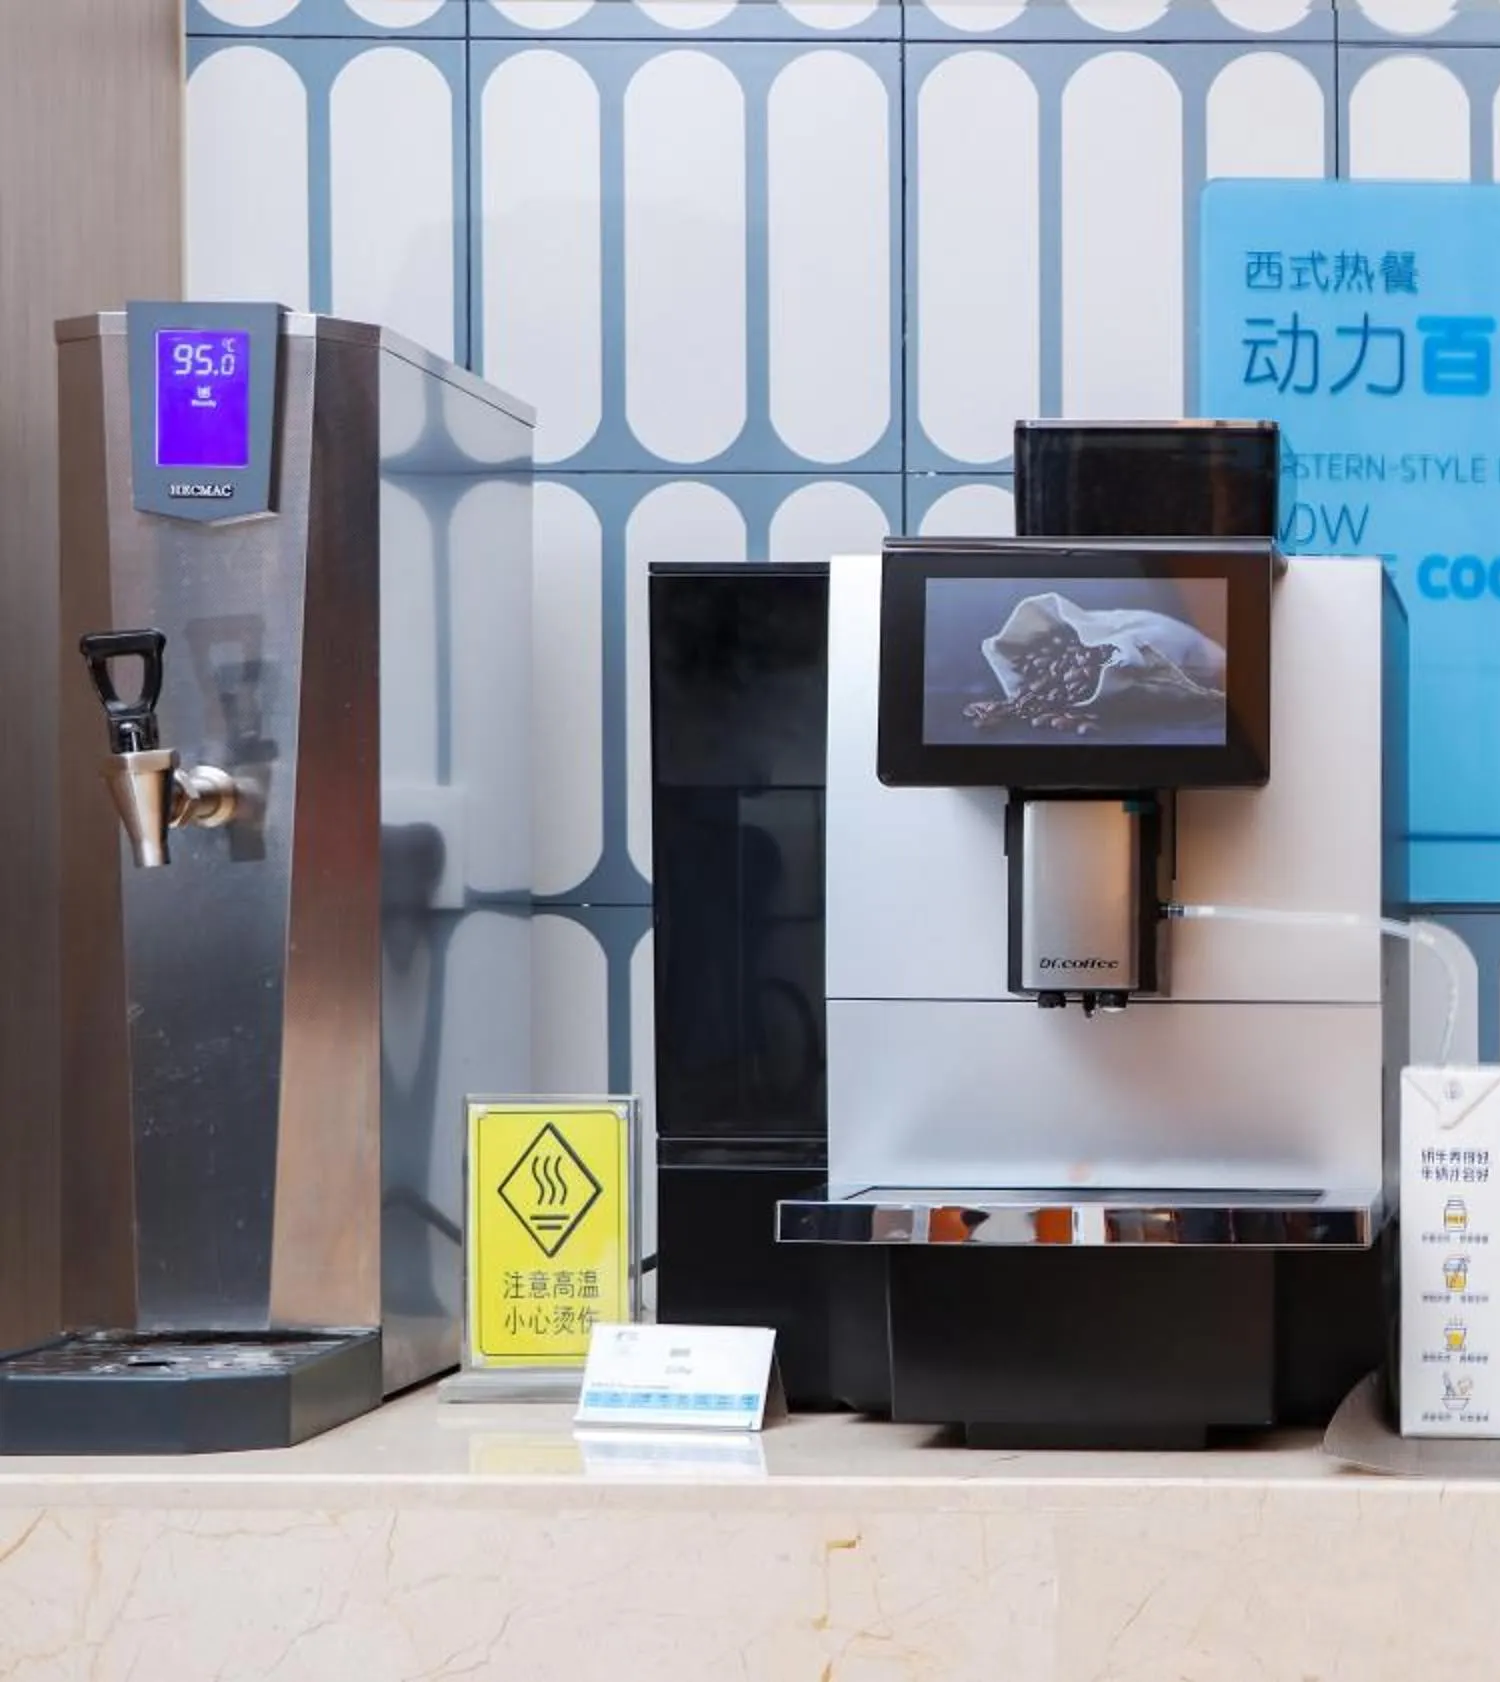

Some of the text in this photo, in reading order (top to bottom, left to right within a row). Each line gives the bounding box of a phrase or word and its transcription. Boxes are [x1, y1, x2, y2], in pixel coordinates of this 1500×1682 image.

[1244, 250, 1420, 295] 西式热餐
[1282, 453, 1486, 483] STERN-STYLE
[170, 484, 232, 497] HECMAC
[1280, 501, 1369, 546] OW
[503, 1271, 600, 1299] 注意高温
